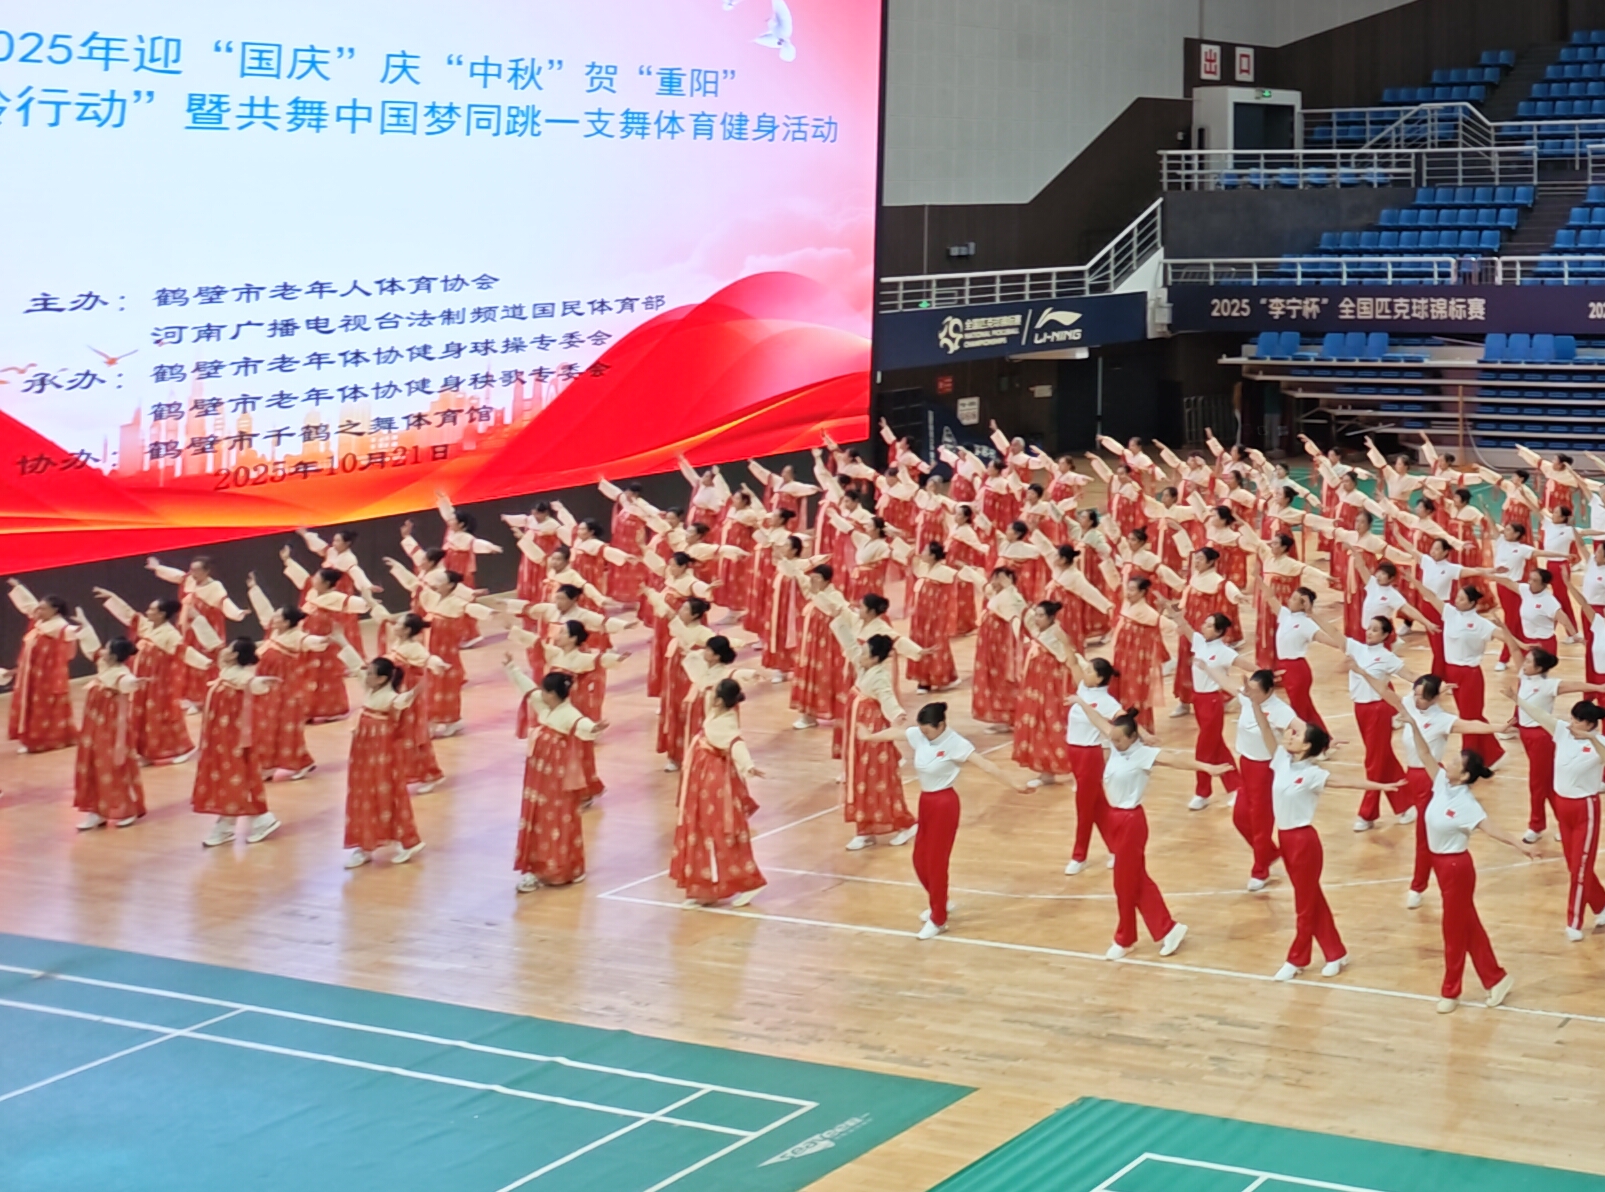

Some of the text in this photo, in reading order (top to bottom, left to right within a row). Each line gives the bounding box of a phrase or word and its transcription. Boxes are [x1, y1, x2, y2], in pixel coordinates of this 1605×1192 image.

[1204, 49, 1251, 76] 出口
[0, 85, 839, 144] 行动”暨共舞中国梦同跳一支舞体育健身活动
[151, 273, 500, 308] 鹤壁市老年人体育协会
[1210, 298, 1251, 318] 2025
[1338, 297, 1487, 321] 全国匹克球锦标赛
[149, 294, 666, 345] 河南广播电视台法制频道国民体育部
[1033, 328, 1083, 345] LI-NING
[149, 329, 613, 384] 鹤壁市老年体协健身球操专委会
[147, 362, 612, 422] 鹤壁市老年体协健身秧歌专委会
[145, 405, 494, 461] 鹤壁市千鹤之舞体育馆
[213, 445, 449, 491] 2025年10月21日
